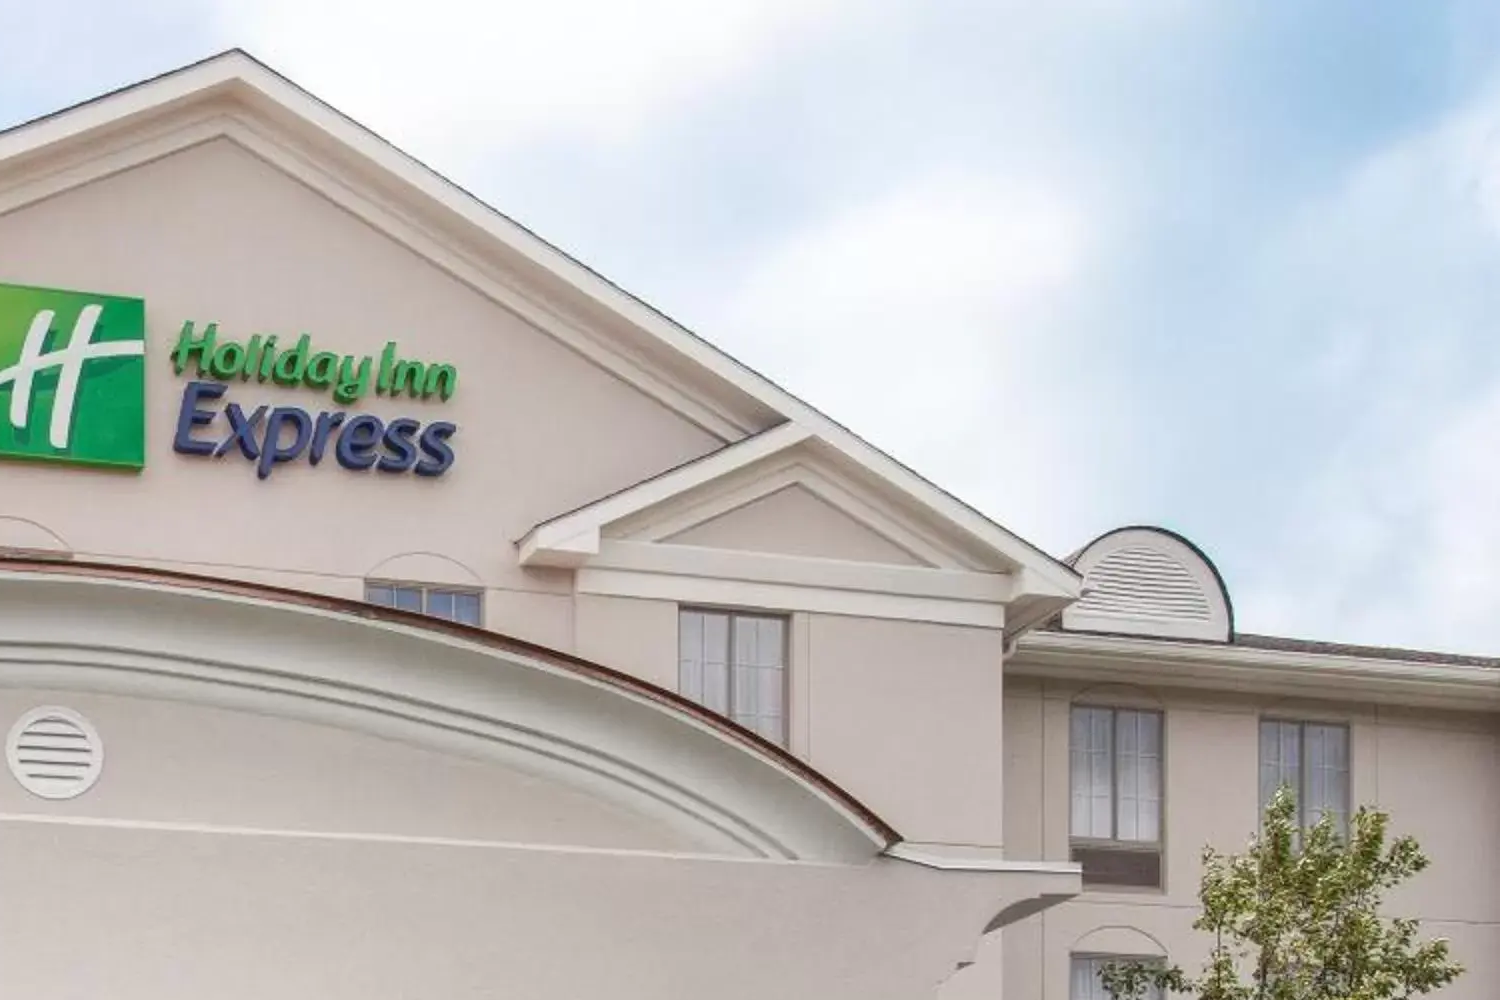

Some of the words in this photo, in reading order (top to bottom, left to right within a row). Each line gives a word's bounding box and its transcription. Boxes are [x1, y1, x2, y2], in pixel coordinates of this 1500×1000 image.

[171, 320, 373, 405] Holiday
[376, 341, 457, 403] Inn
[173, 380, 457, 480] Express
